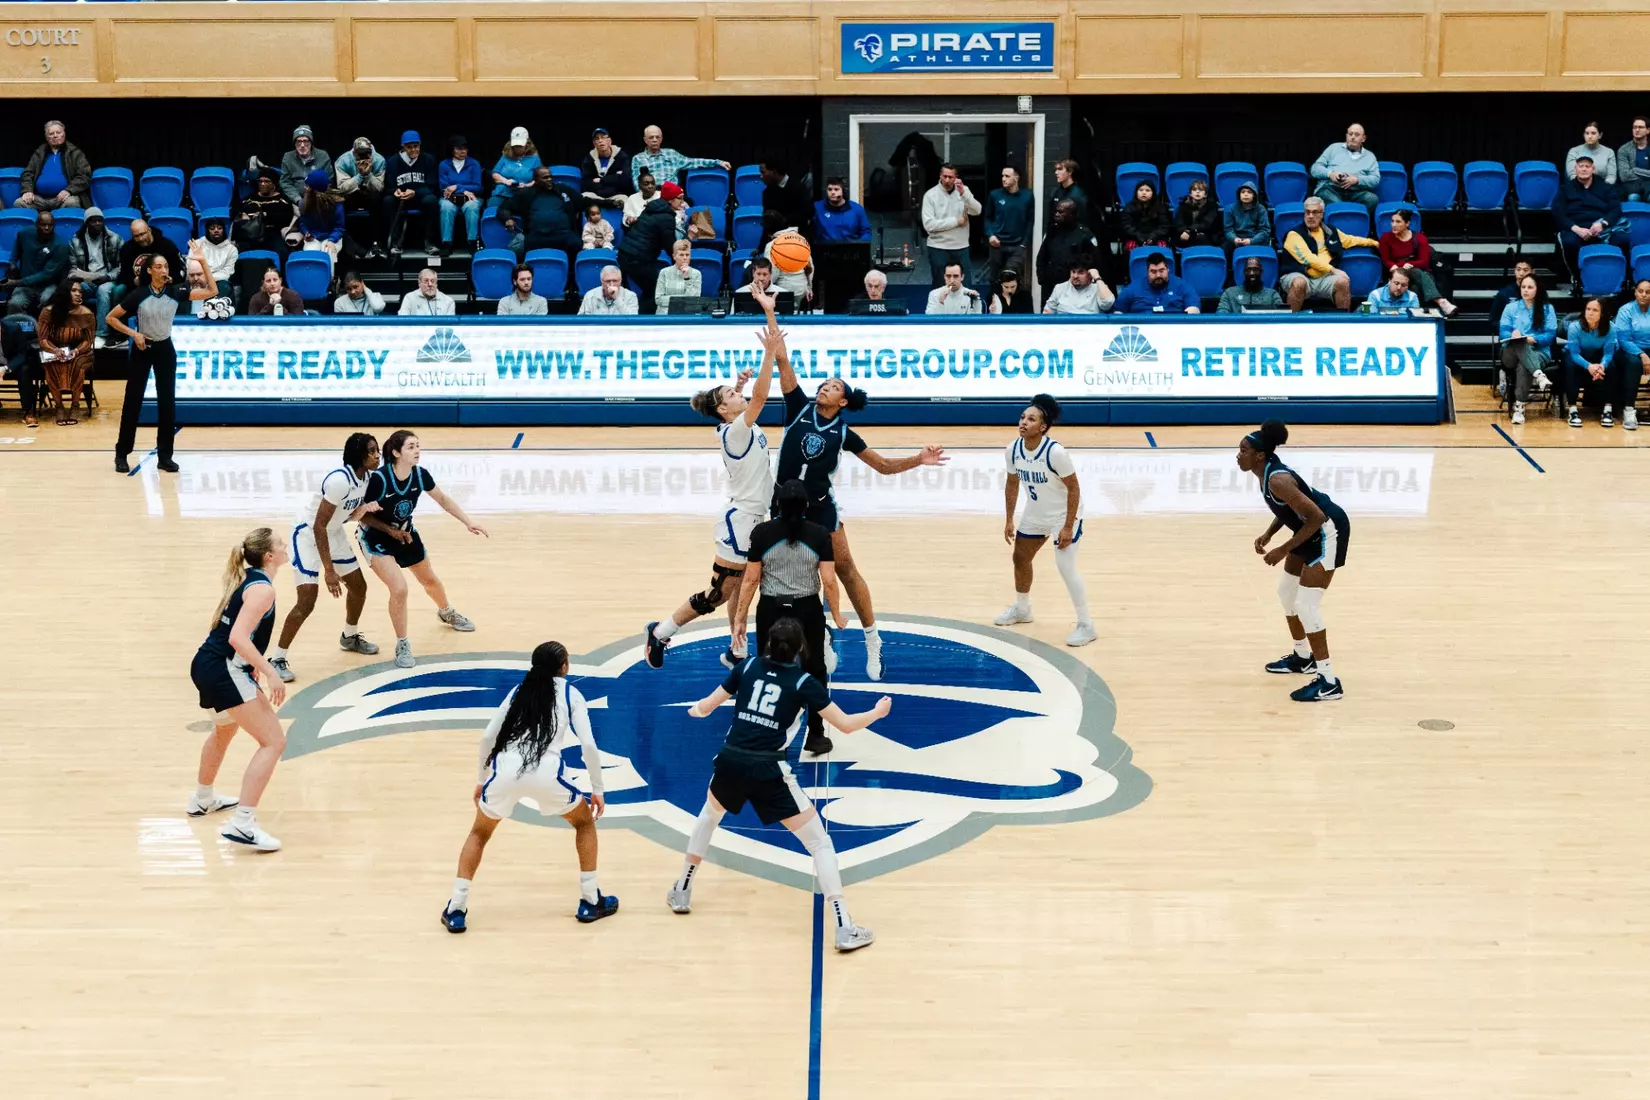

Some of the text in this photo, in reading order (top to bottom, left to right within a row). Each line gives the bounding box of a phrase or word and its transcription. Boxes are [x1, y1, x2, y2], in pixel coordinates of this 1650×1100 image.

[5, 28, 80, 46] COURT
[890, 32, 1042, 51] PIRATE
[41, 56, 51, 74] 3
[869, 304, 887, 313] POSS.
[174, 350, 390, 380] ETIRE READY
[495, 349, 1074, 379] WWW.THEGENWALTHGROUP.COM
[1181, 346, 1429, 377] RETIRE READY
[1028, 485, 1038, 501] 5
[747, 678, 782, 717] 12
